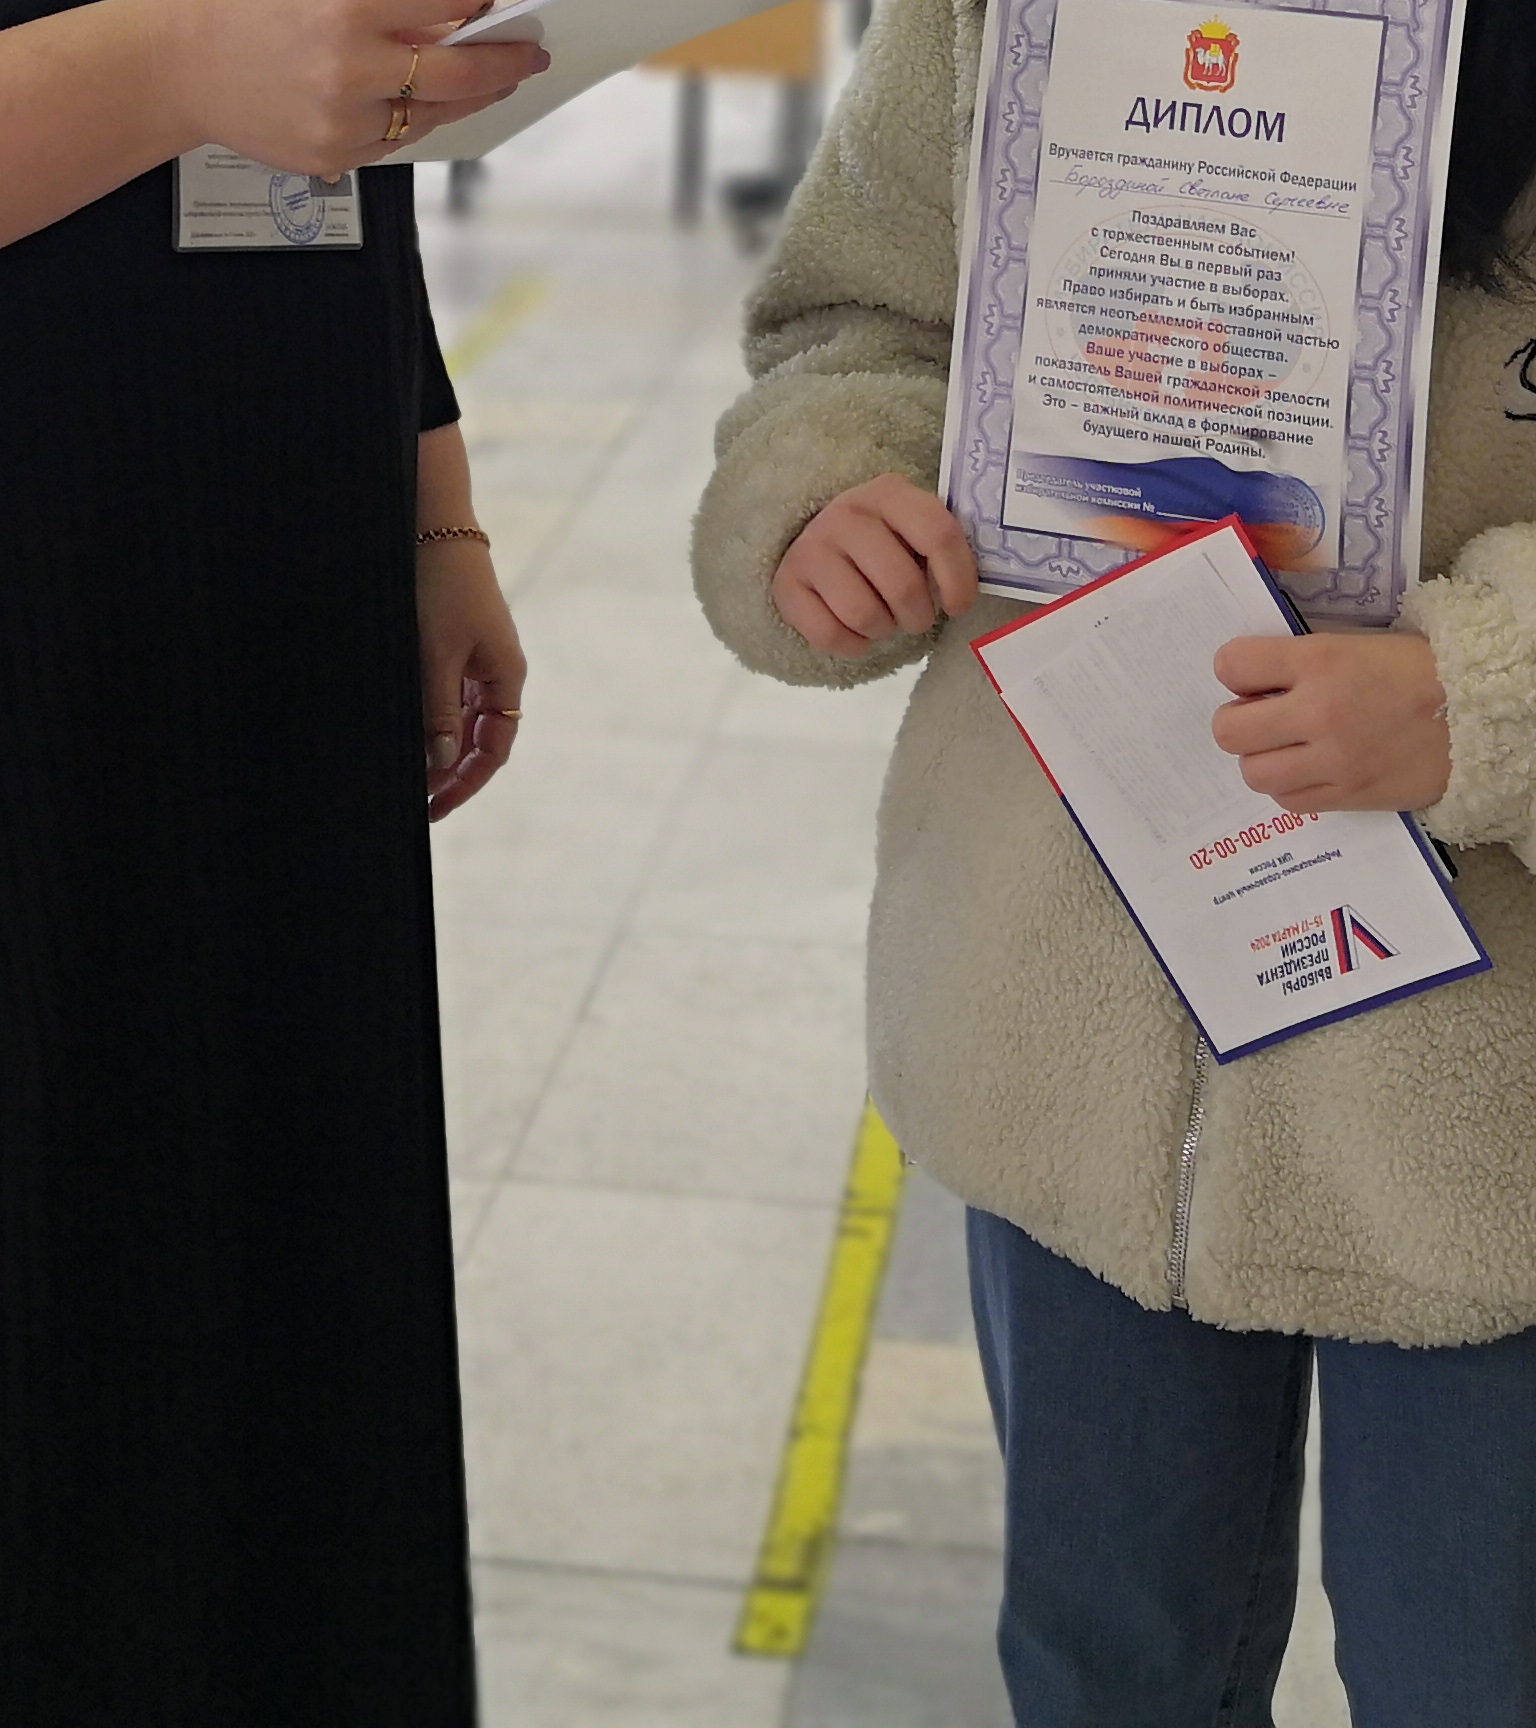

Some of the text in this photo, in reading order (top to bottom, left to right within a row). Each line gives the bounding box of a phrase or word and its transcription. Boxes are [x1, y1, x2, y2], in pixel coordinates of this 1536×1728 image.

[1123, 95, 1287, 143] ДИПЛОМ
[1047, 141, 1357, 192] Вручается гражданину Российской Федерации
[1089, 225, 1296, 264] с торжественным событием!
[1130, 208, 1257, 239] Поздравляем Вас
[1098, 243, 1156, 265] Сегодня
[1183, 257, 1194, 271] в
[1195, 259, 1253, 278] первый
[1254, 267, 1282, 283] раз
[1061, 277, 1315, 327] Право избирать и быть избранным
[1087, 264, 1289, 305] приняли участие в выборах.
[1034, 296, 1341, 350] является неотъемлемой составной частью
[1076, 322, 1289, 363] демократического общества.
[1084, 339, 1125, 359] Ваше
[1126, 348, 1184, 368] участие
[1186, 357, 1196, 370] в
[1198, 359, 1264, 381] выборах
[1027, 373, 1334, 429] и самостоятельной политической позиции.
[1033, 354, 1330, 410] показатель Вашей гражданской зрелости
[1040, 392, 1067, 409] Это
[1081, 397, 1142, 421] важный
[1141, 407, 1185, 430] вклад
[1186, 416, 1197, 430] в
[1199, 414, 1314, 446] формирование
[1081, 417, 1270, 460] будущего нашей Родины.
[1188, 813, 1318, 870] 800-200-00-20
[1270, 922, 1299, 943] МАРТА
[1280, 929, 1326, 959] РОССИИ
[1255, 947, 1329, 986] ПРЕЗИДЕНТА
[1281, 965, 1333, 996] ВЫБОРЫ
